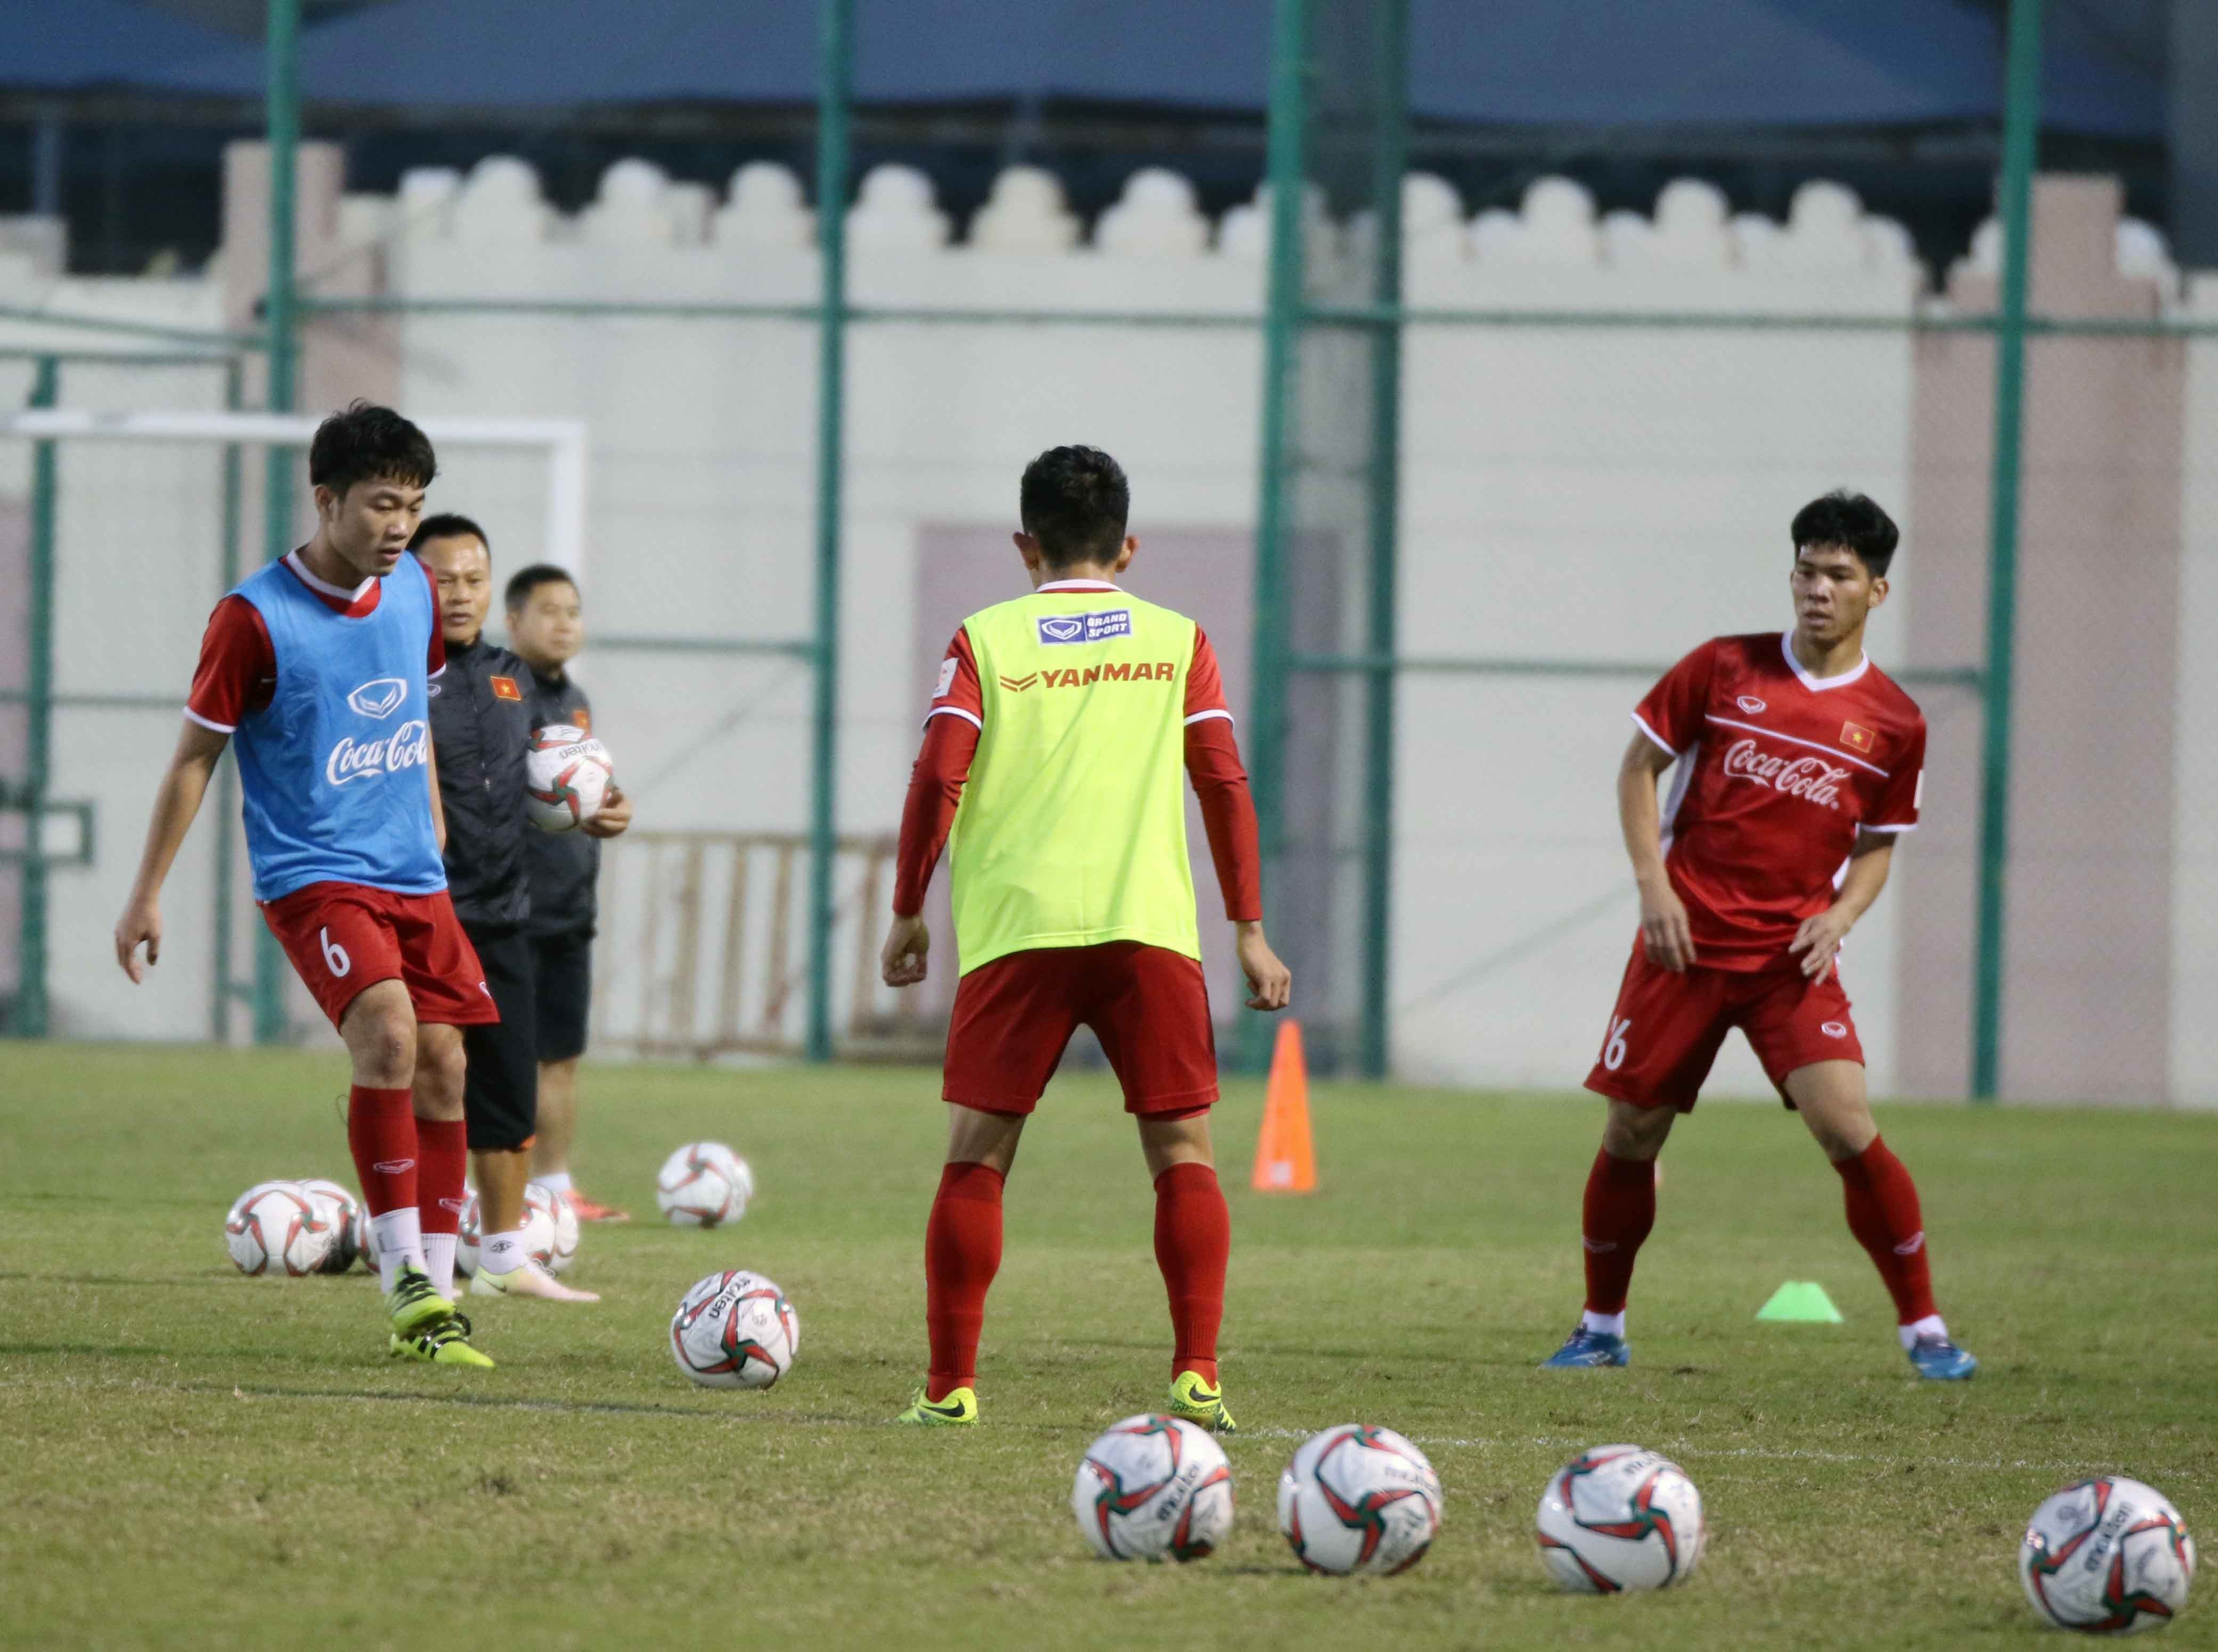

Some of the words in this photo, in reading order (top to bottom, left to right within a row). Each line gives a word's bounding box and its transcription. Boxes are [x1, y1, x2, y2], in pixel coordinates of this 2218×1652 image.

[1087, 614, 1127, 627] GRAND
[1088, 623, 1128, 637] SPORT
[1041, 663, 1174, 688] YANMAR
[1724, 739, 1852, 806] Coca-Cola
[320, 926, 351, 978] 6
